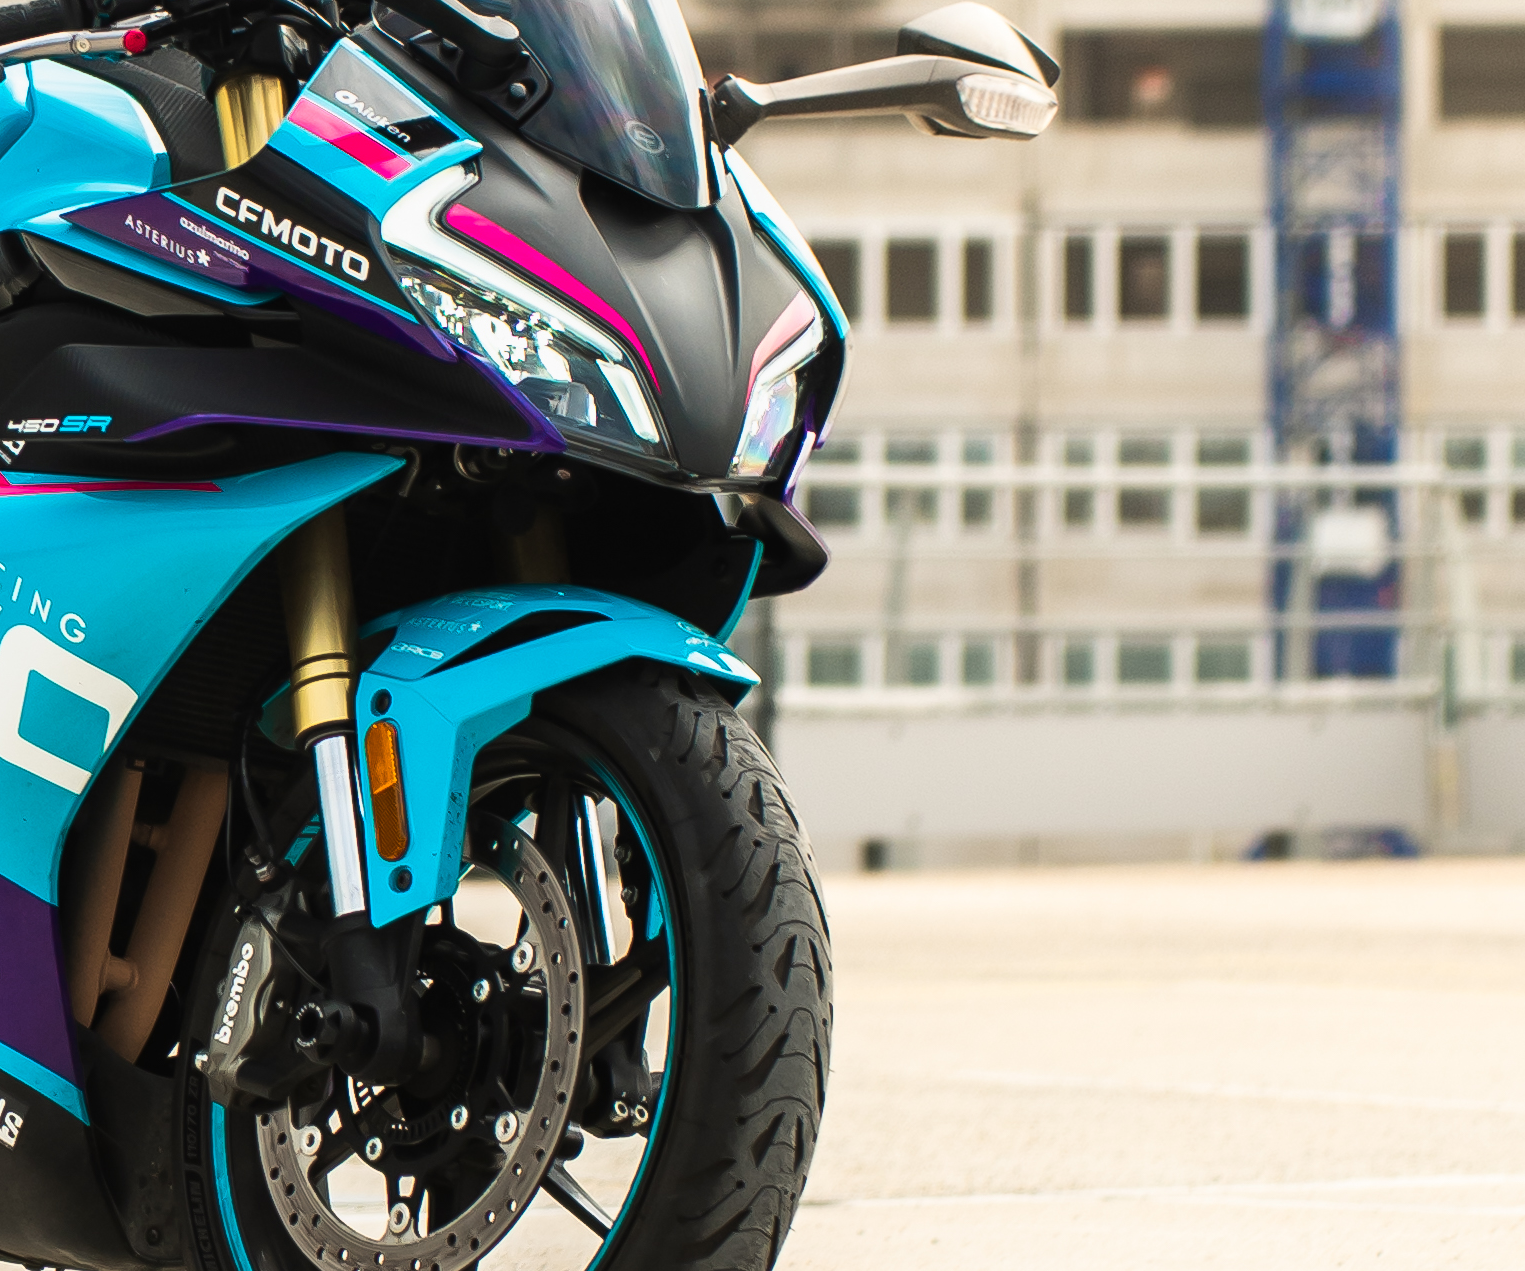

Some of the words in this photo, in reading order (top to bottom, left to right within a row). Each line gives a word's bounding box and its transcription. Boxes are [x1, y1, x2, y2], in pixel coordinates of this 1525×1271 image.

[124, 213, 195, 264] ASTERIUS
[215, 186, 370, 281] CFMOTO
[214, 942, 254, 1045] brembo
